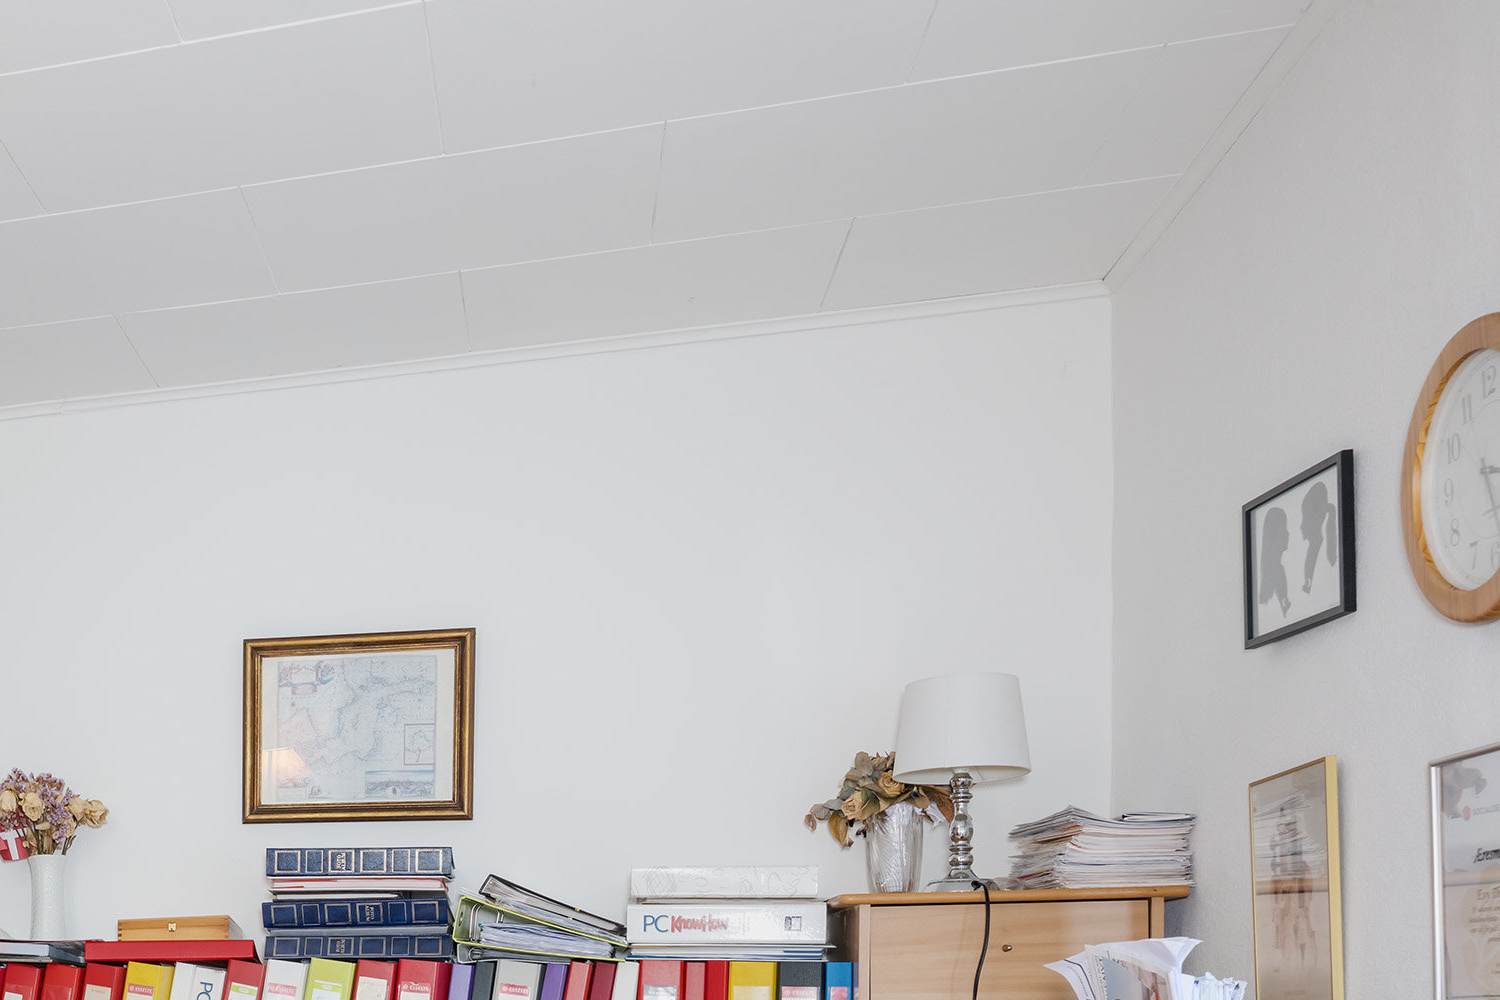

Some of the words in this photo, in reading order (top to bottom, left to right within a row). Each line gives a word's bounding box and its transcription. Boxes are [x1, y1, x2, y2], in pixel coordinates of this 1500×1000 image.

[1483, 364, 1497, 401] 12
[1460, 394, 1475, 424] 11
[1448, 433, 1461, 464] 10
[1444, 478, 1454, 508] 9
[1450, 518, 1461, 547] 8
[1469, 540, 1479, 570] 7
[643, 914, 669, 933] PC
